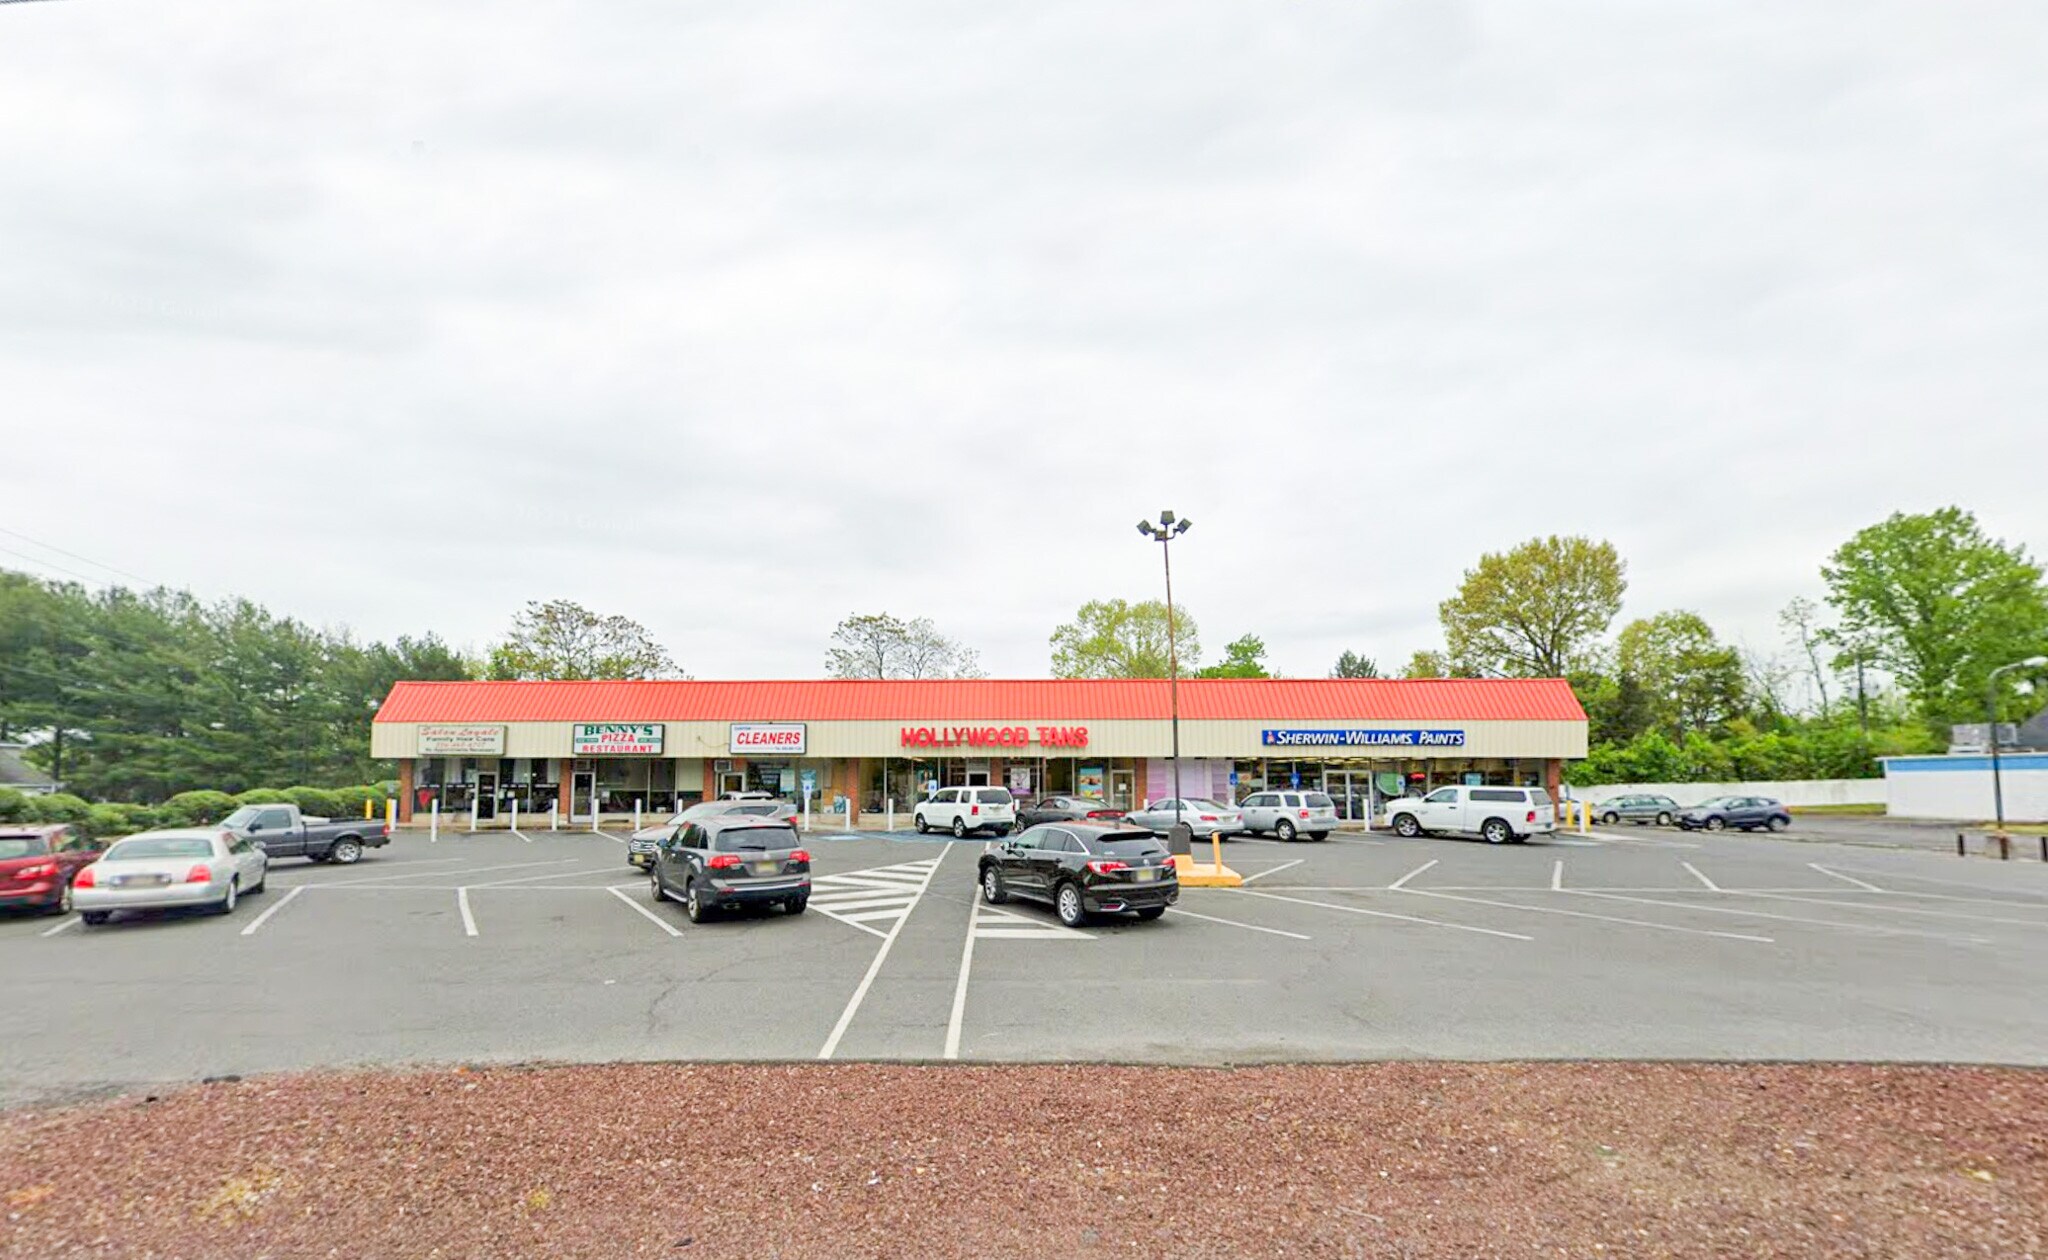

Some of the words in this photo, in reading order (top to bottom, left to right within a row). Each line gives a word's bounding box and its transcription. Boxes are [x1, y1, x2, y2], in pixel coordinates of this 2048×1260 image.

[584, 724, 653, 736] BENNY'S
[601, 733, 635, 743] PIZZA
[737, 732, 801, 745] CLEANERS
[901, 727, 1029, 748] HOLLYWOOD
[1036, 726, 1089, 748] TANS
[1276, 731, 1413, 744] SHERWIN-WILLIAMS
[1418, 731, 1464, 744] PAINTS
